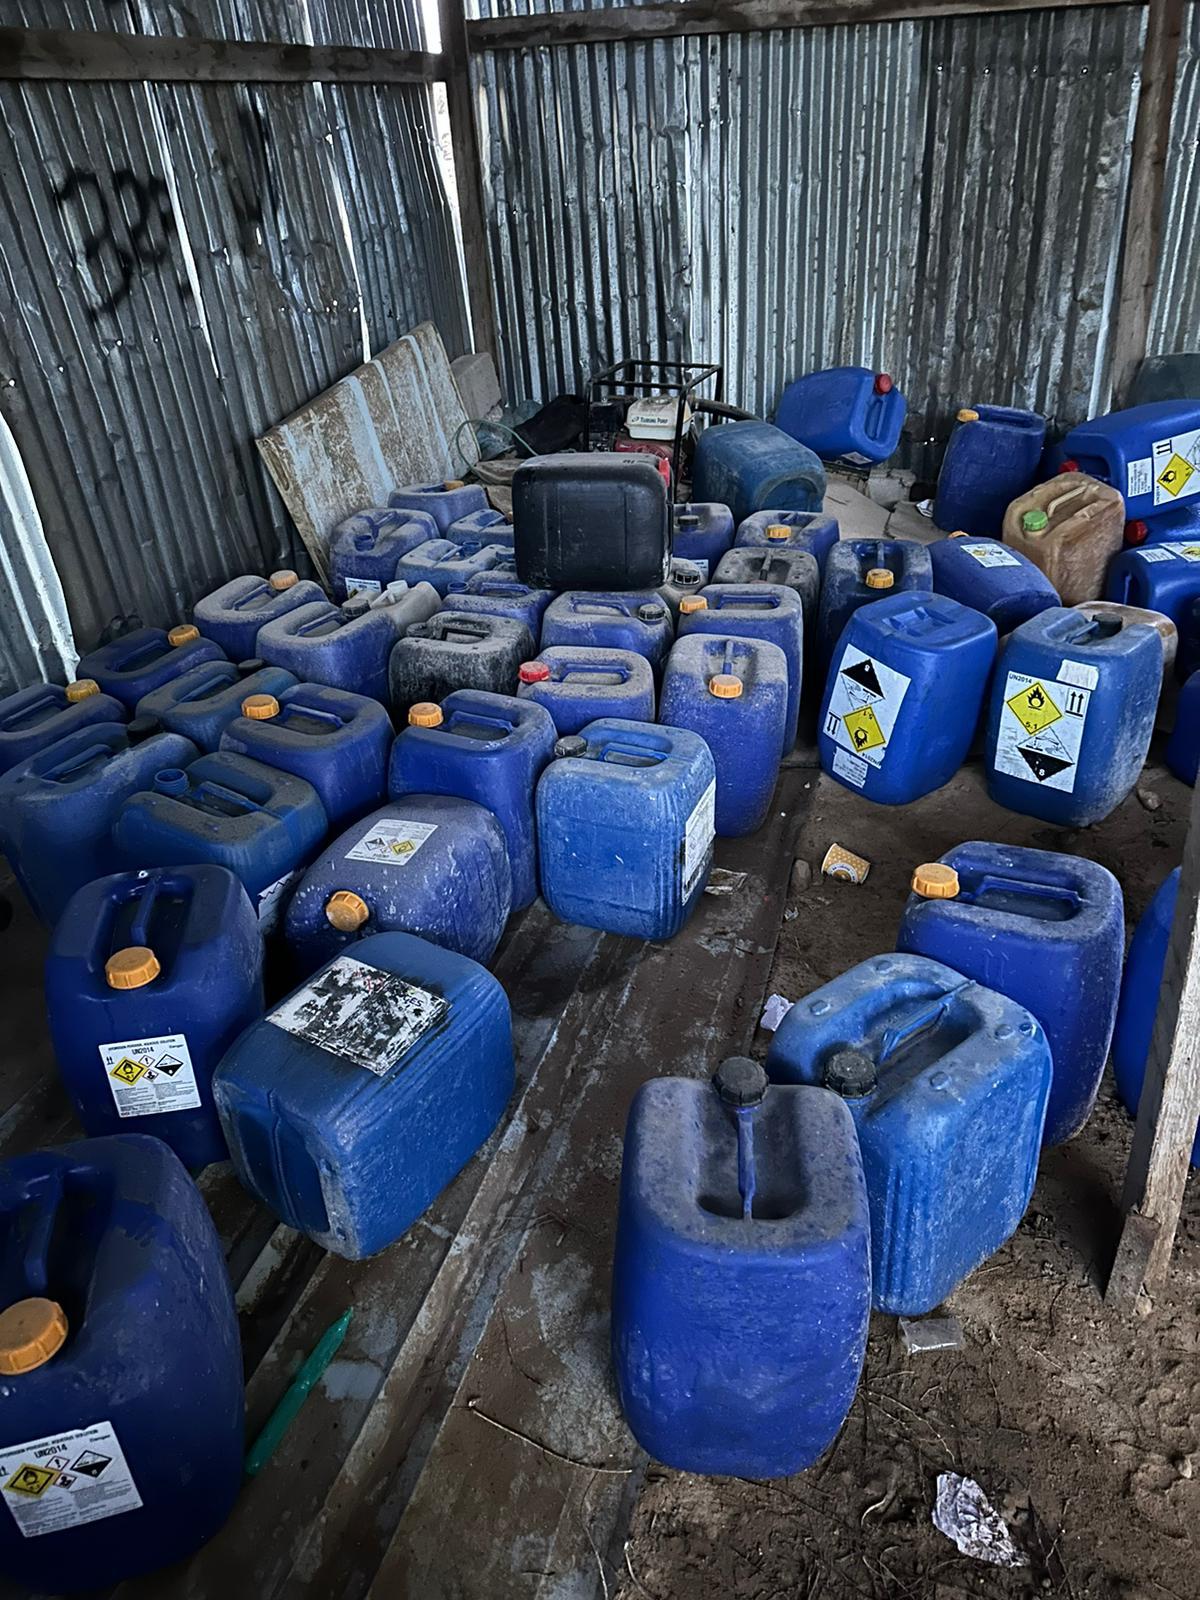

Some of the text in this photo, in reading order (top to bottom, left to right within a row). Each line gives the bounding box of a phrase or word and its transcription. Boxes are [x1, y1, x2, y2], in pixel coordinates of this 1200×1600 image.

[1008, 672, 1033, 684] UN2014
[1025, 721, 1038, 730] 5.1
[1038, 768, 1045, 777] 8
[132, 1046, 154, 1055] UN2014
[34, 1443, 68, 1459] UN2014
